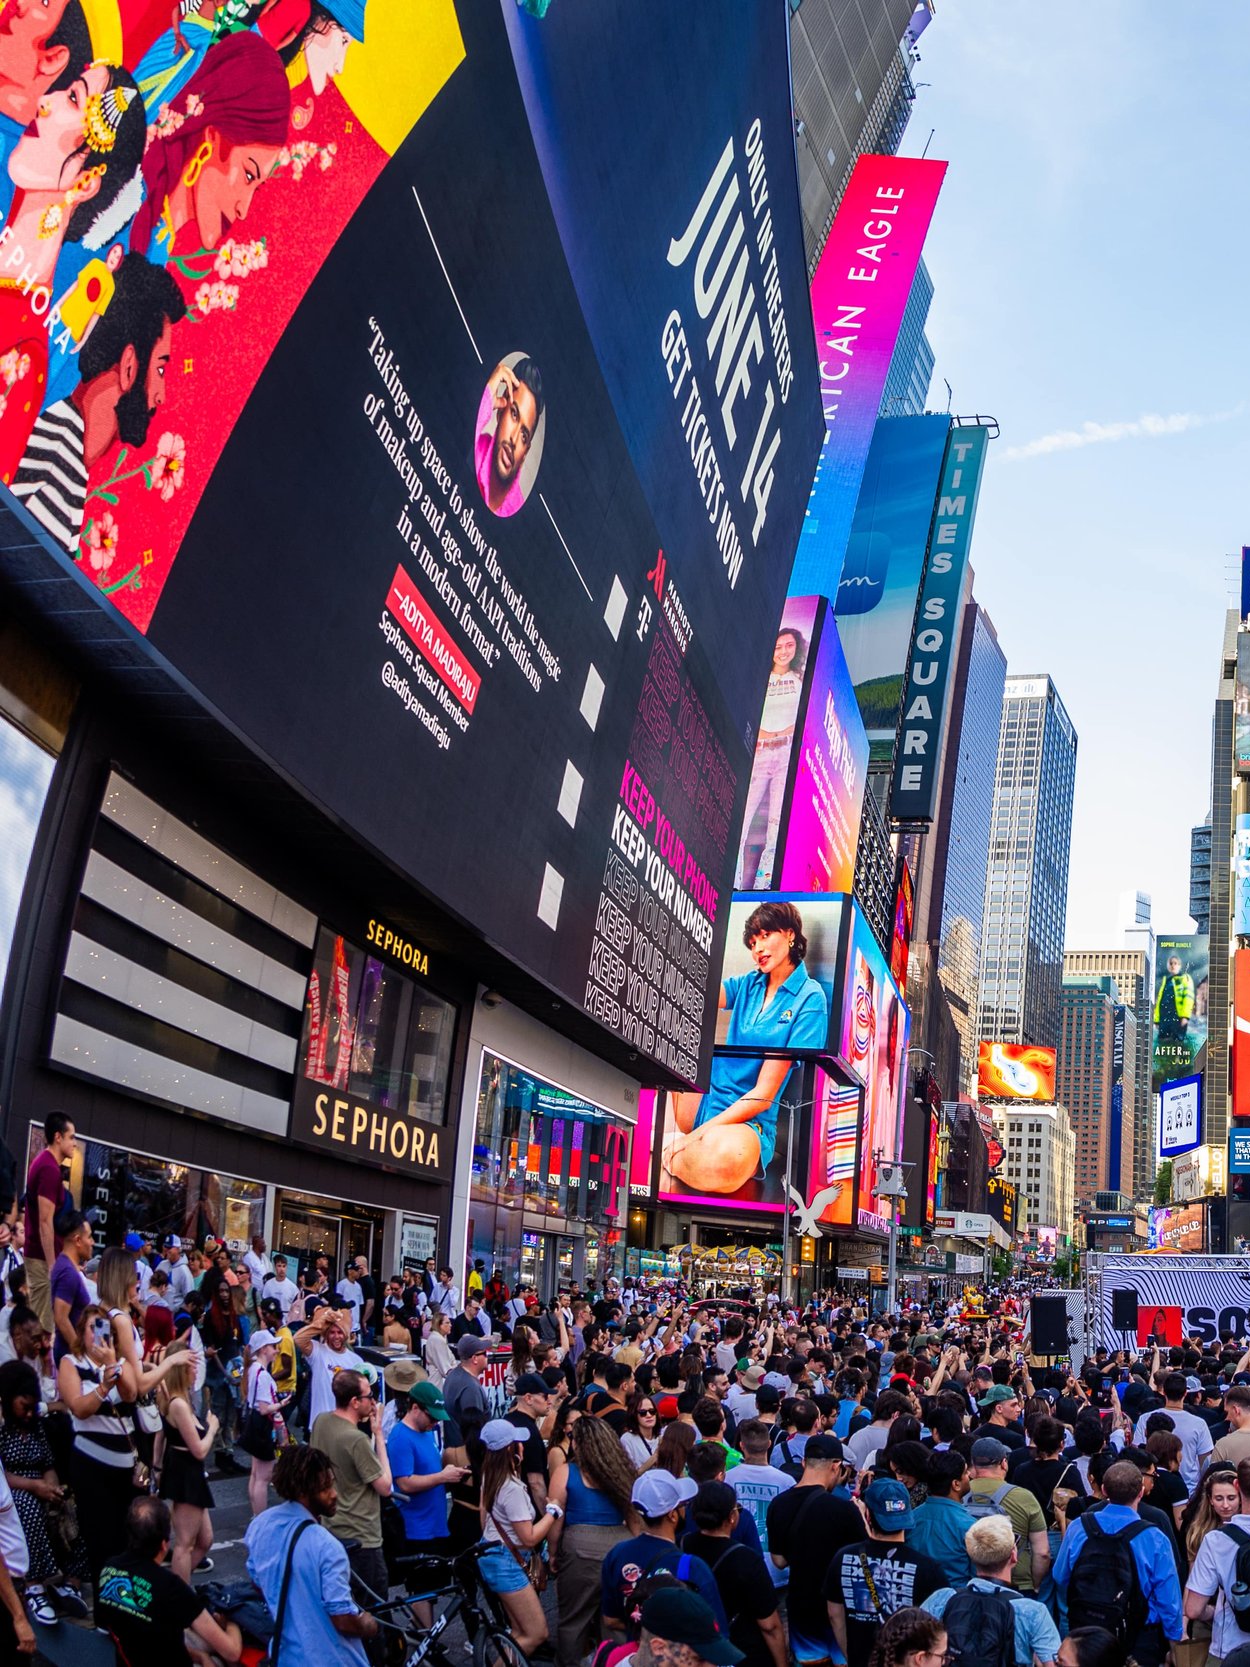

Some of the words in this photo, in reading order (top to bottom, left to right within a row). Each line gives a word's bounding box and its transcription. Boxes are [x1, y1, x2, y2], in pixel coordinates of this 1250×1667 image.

[745, 118, 769, 219] ONLY
[0, 211, 72, 355] EPHORA
[757, 208, 774, 264] IN
[848, 187, 904, 282] EAGLE
[667, 136, 765, 451] JUNE
[741, 380, 781, 547] 14
[763, 248, 794, 404] THEATERS
[661, 309, 692, 399] GET
[682, 376, 725, 524] TICKETS
[716, 500, 744, 591] NOW
[931, 443, 973, 574] TIMES
[363, 393, 386, 425] of
[375, 415, 423, 503] makeup
[420, 494, 447, 539] and
[441, 529, 482, 598] age-old
[477, 586, 503, 635] AAPI
[501, 621, 542, 692] traditions
[396, 505, 413, 543] in
[410, 533, 422, 556] a
[418, 545, 462, 619] modern
[406, 407, 424, 444] up
[421, 437, 452, 495] space
[449, 484, 463, 515] to
[460, 507, 488, 558] show
[485, 547, 502, 584] the
[501, 575, 528, 624] world
[524, 612, 540, 646] the
[537, 638, 562, 682] magic
[379, 610, 414, 665] Sephora
[412, 653, 439, 695] Squad
[437, 686, 470, 732] Member
[432, 638, 477, 702] MADIRAJU
[663, 597, 687, 652] MARQUIS
[667, 580, 694, 641] MARRIOTT
[381, 661, 451, 749] @adityamadiraju
[900, 597, 945, 791] SQUARE
[611, 804, 646, 868] KEEP
[645, 843, 676, 910] YOUR
[673, 885, 714, 955] NUMBER
[619, 760, 655, 830] KEEP
[654, 807, 687, 878] YOUR
[684, 853, 719, 923] PHONE
[366, 919, 429, 976] SEPHORA
[588, 936, 627, 996] KEEP
[627, 966, 658, 1028] YOUR
[658, 994, 701, 1060] NUMBER
[596, 892, 632, 954] KEEP
[631, 926, 663, 990] YOUR
[663, 957, 705, 1026] NUMBER
[1155, 1046, 1182, 1056] AFTER
[312, 1094, 440, 1168] SEPHORA
